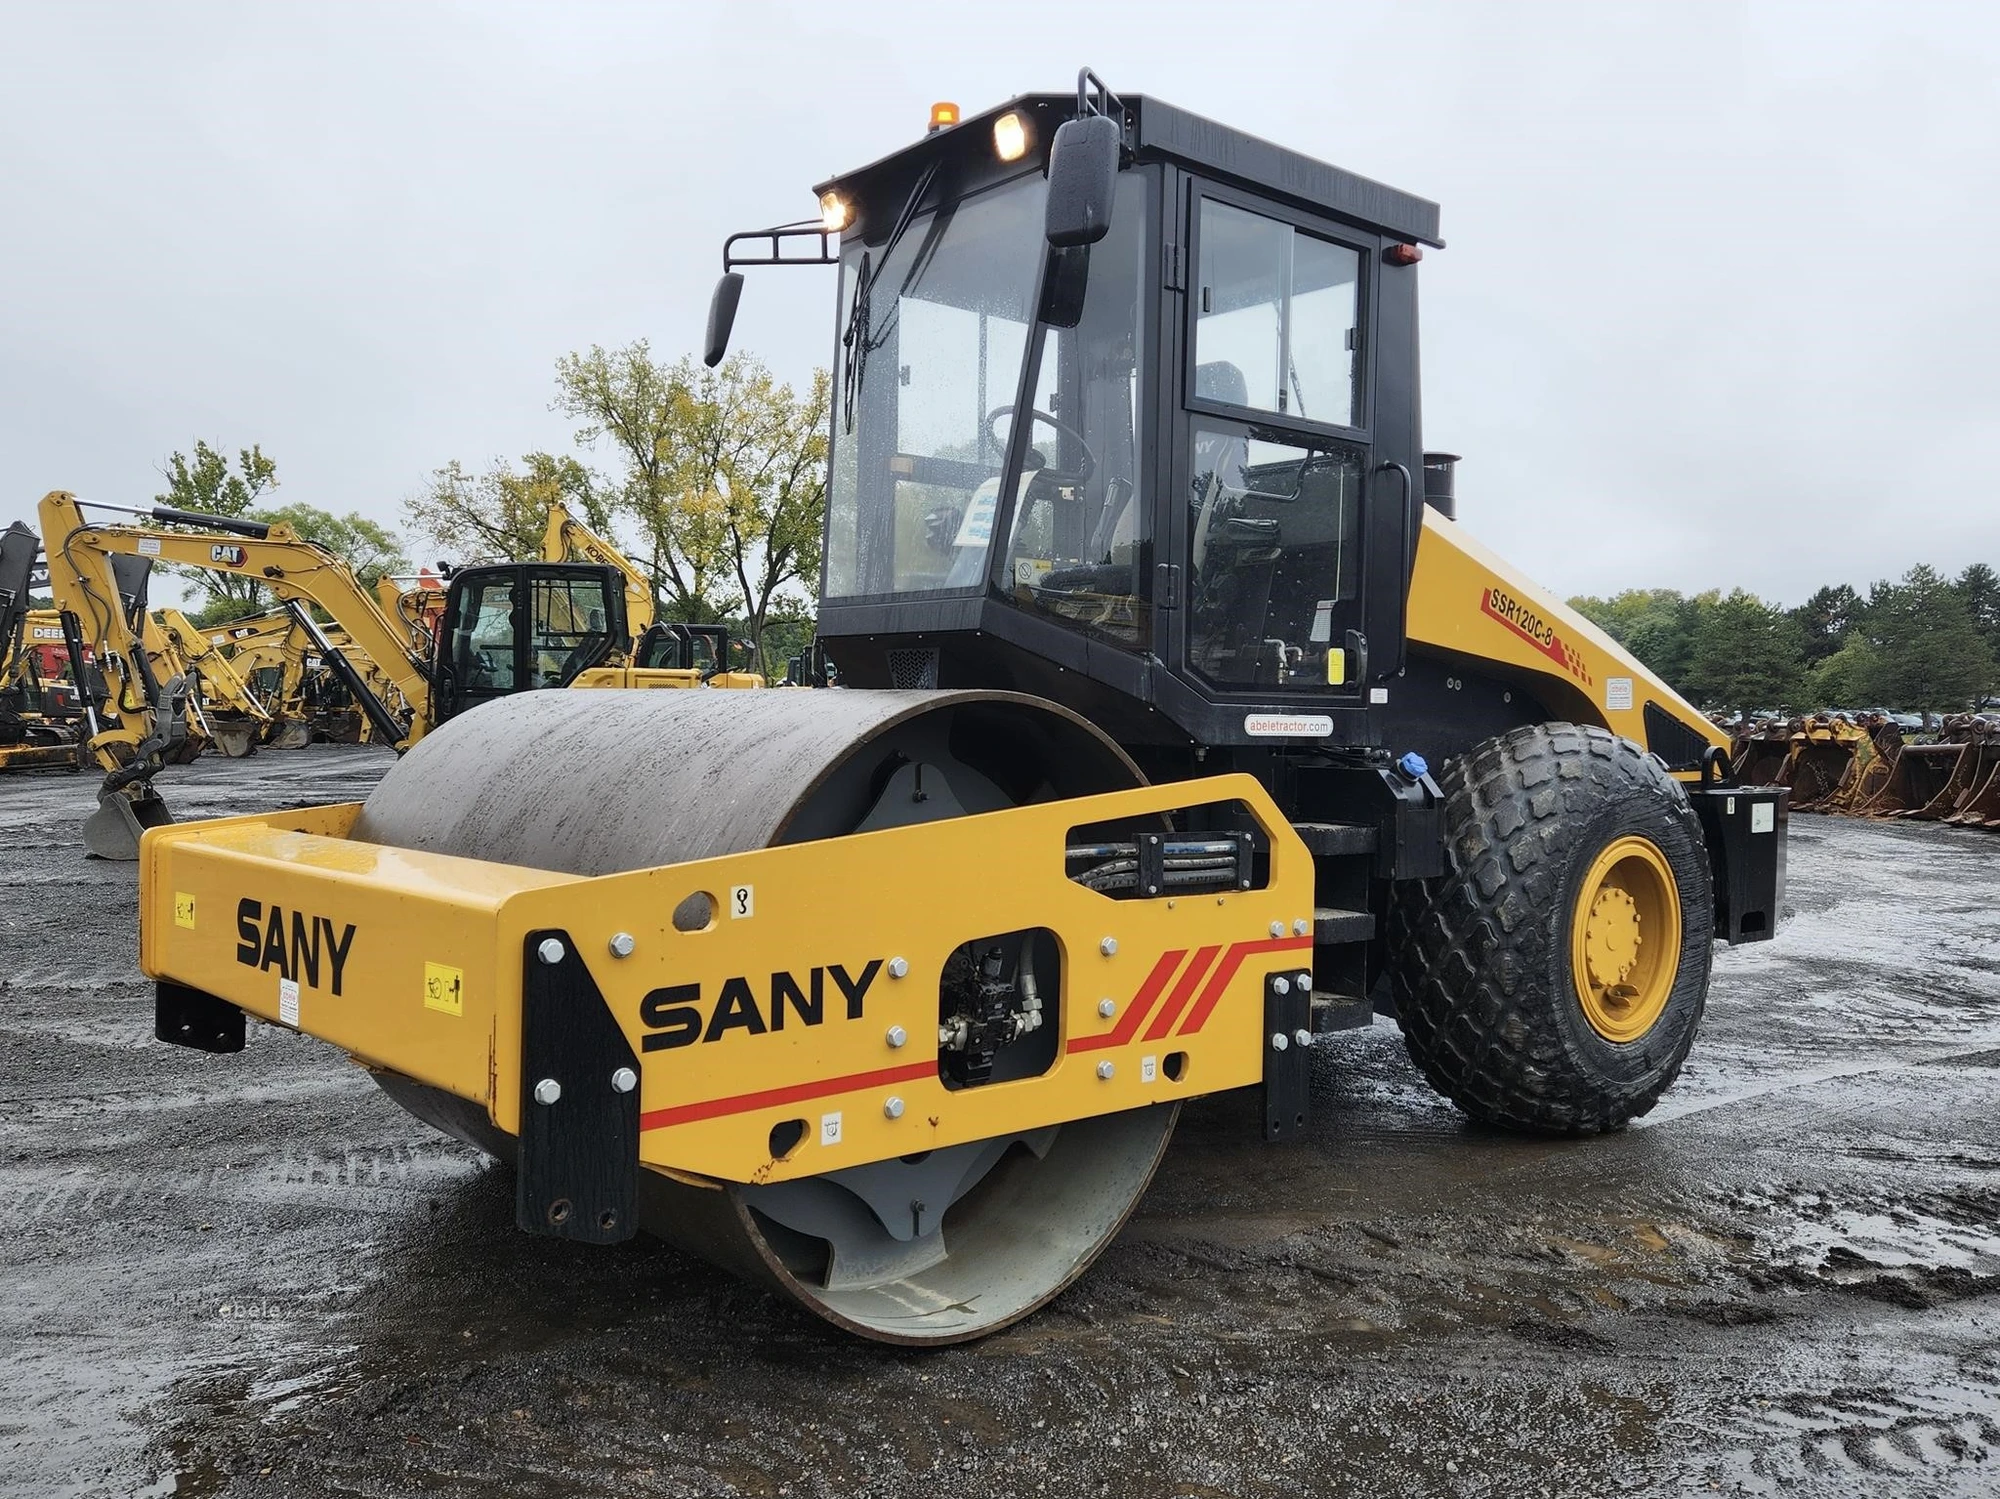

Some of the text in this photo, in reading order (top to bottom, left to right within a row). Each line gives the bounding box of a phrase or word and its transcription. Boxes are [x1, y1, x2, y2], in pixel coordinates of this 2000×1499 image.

[211, 545, 240, 563] CAT
[1491, 588, 1553, 646] SSR120C-8
[1250, 721, 1329, 732] abeletractor.com
[237, 897, 357, 997] SANY
[640, 959, 884, 1053] SANY
